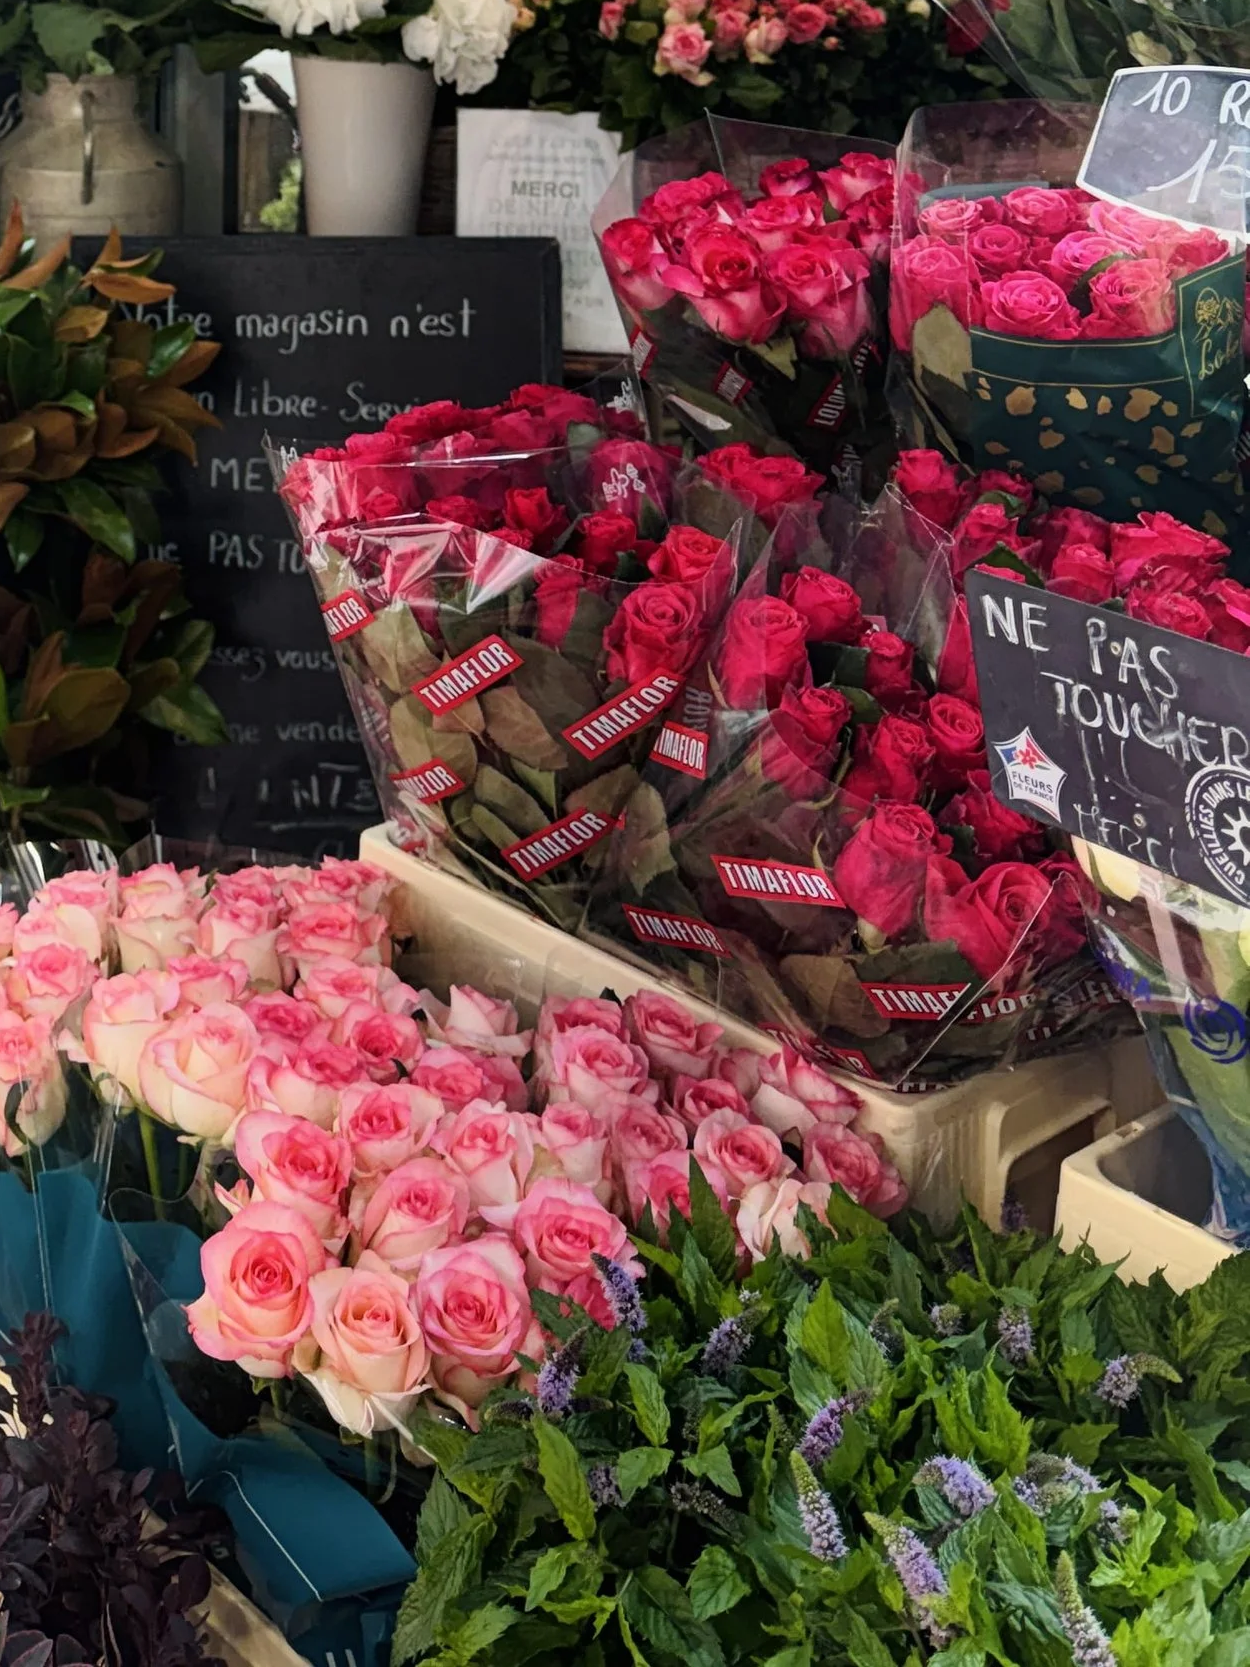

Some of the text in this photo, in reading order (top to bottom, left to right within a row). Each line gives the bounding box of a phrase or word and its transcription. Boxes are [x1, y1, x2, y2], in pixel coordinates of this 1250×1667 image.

[1132, 72, 1191, 116] 10
[510, 180, 580, 199] MERCI
[236, 308, 369, 354] magasin
[390, 298, 477, 337] n'est
[210, 457, 279, 493] ME
[209, 530, 264, 570] PAS
[209, 647, 267, 682] ssez
[981, 593, 1179, 702] NE PAS
[419, 642, 515, 708] TIMAFLOR
[571, 675, 679, 751] TIMAFLOR
[1039, 671, 1250, 770] TOUCHER
[1011, 771, 1053, 794] FLEURS
[1013, 781, 1054, 803] DE FRANCE
[1202, 780, 1236, 809] DANS
[509, 812, 608, 874] TIMAFLOR
[719, 861, 836, 901] TIMAFLOR
[629, 910, 725, 953] TIMAFLOR
